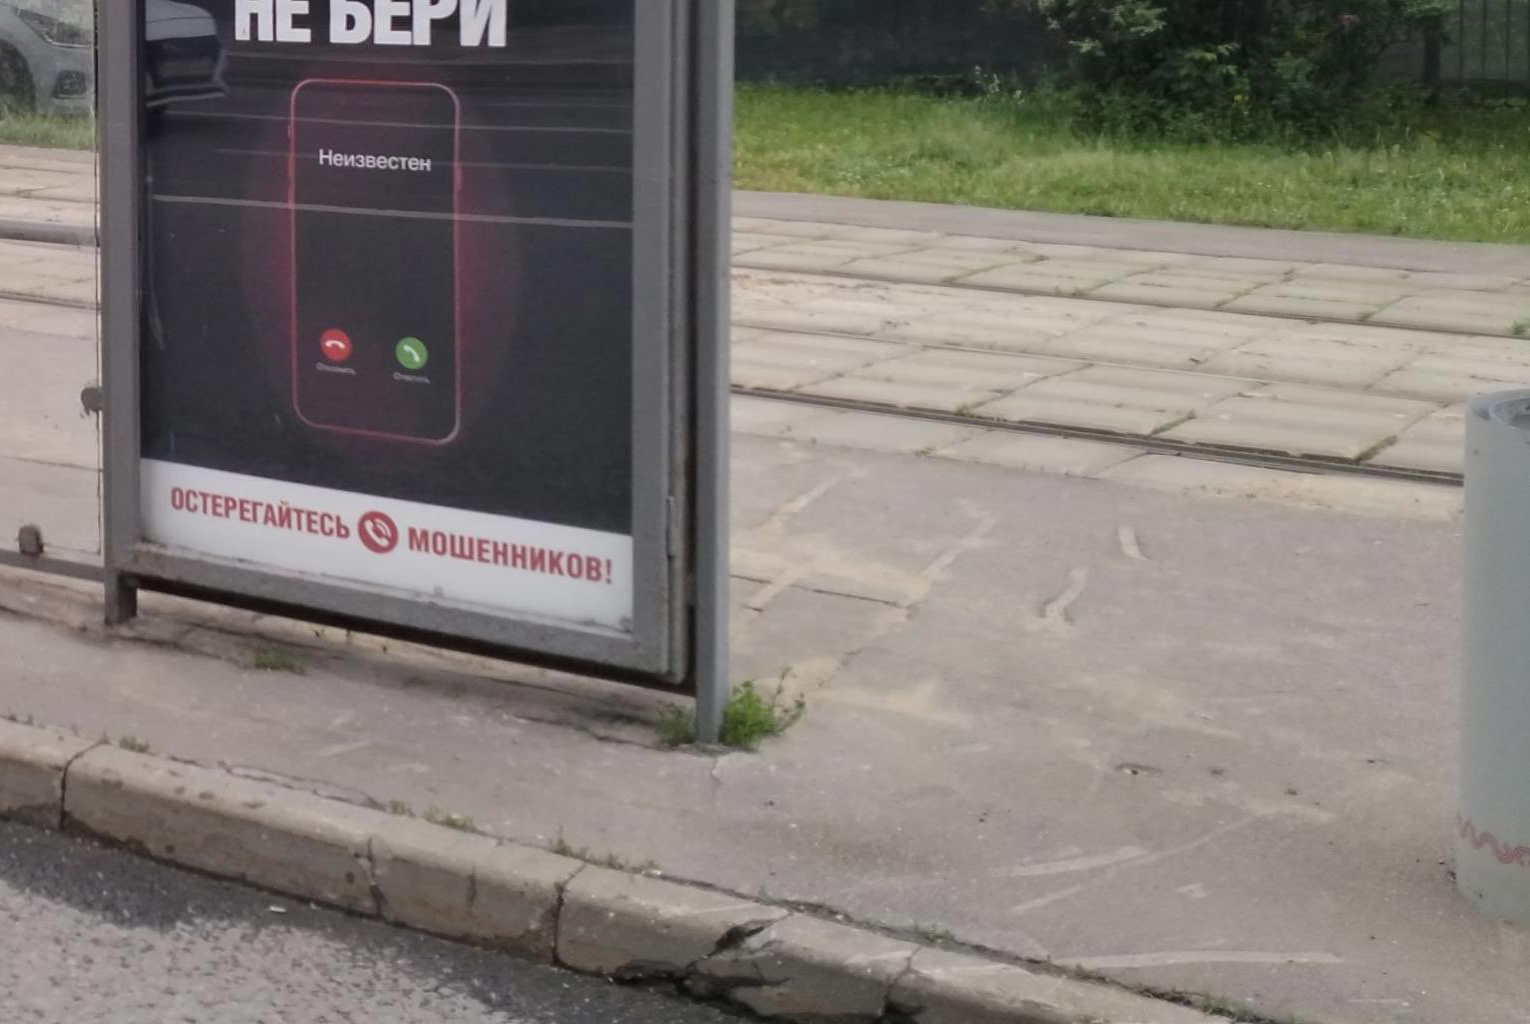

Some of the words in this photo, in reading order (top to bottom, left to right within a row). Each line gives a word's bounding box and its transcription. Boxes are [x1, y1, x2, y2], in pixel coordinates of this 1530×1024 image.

[318, 148, 432, 172] Неизвестен
[170, 486, 351, 540] ОСТЕРЕГАЙТЕСЬ
[408, 526, 613, 585] МОШЕННИКОВ!
